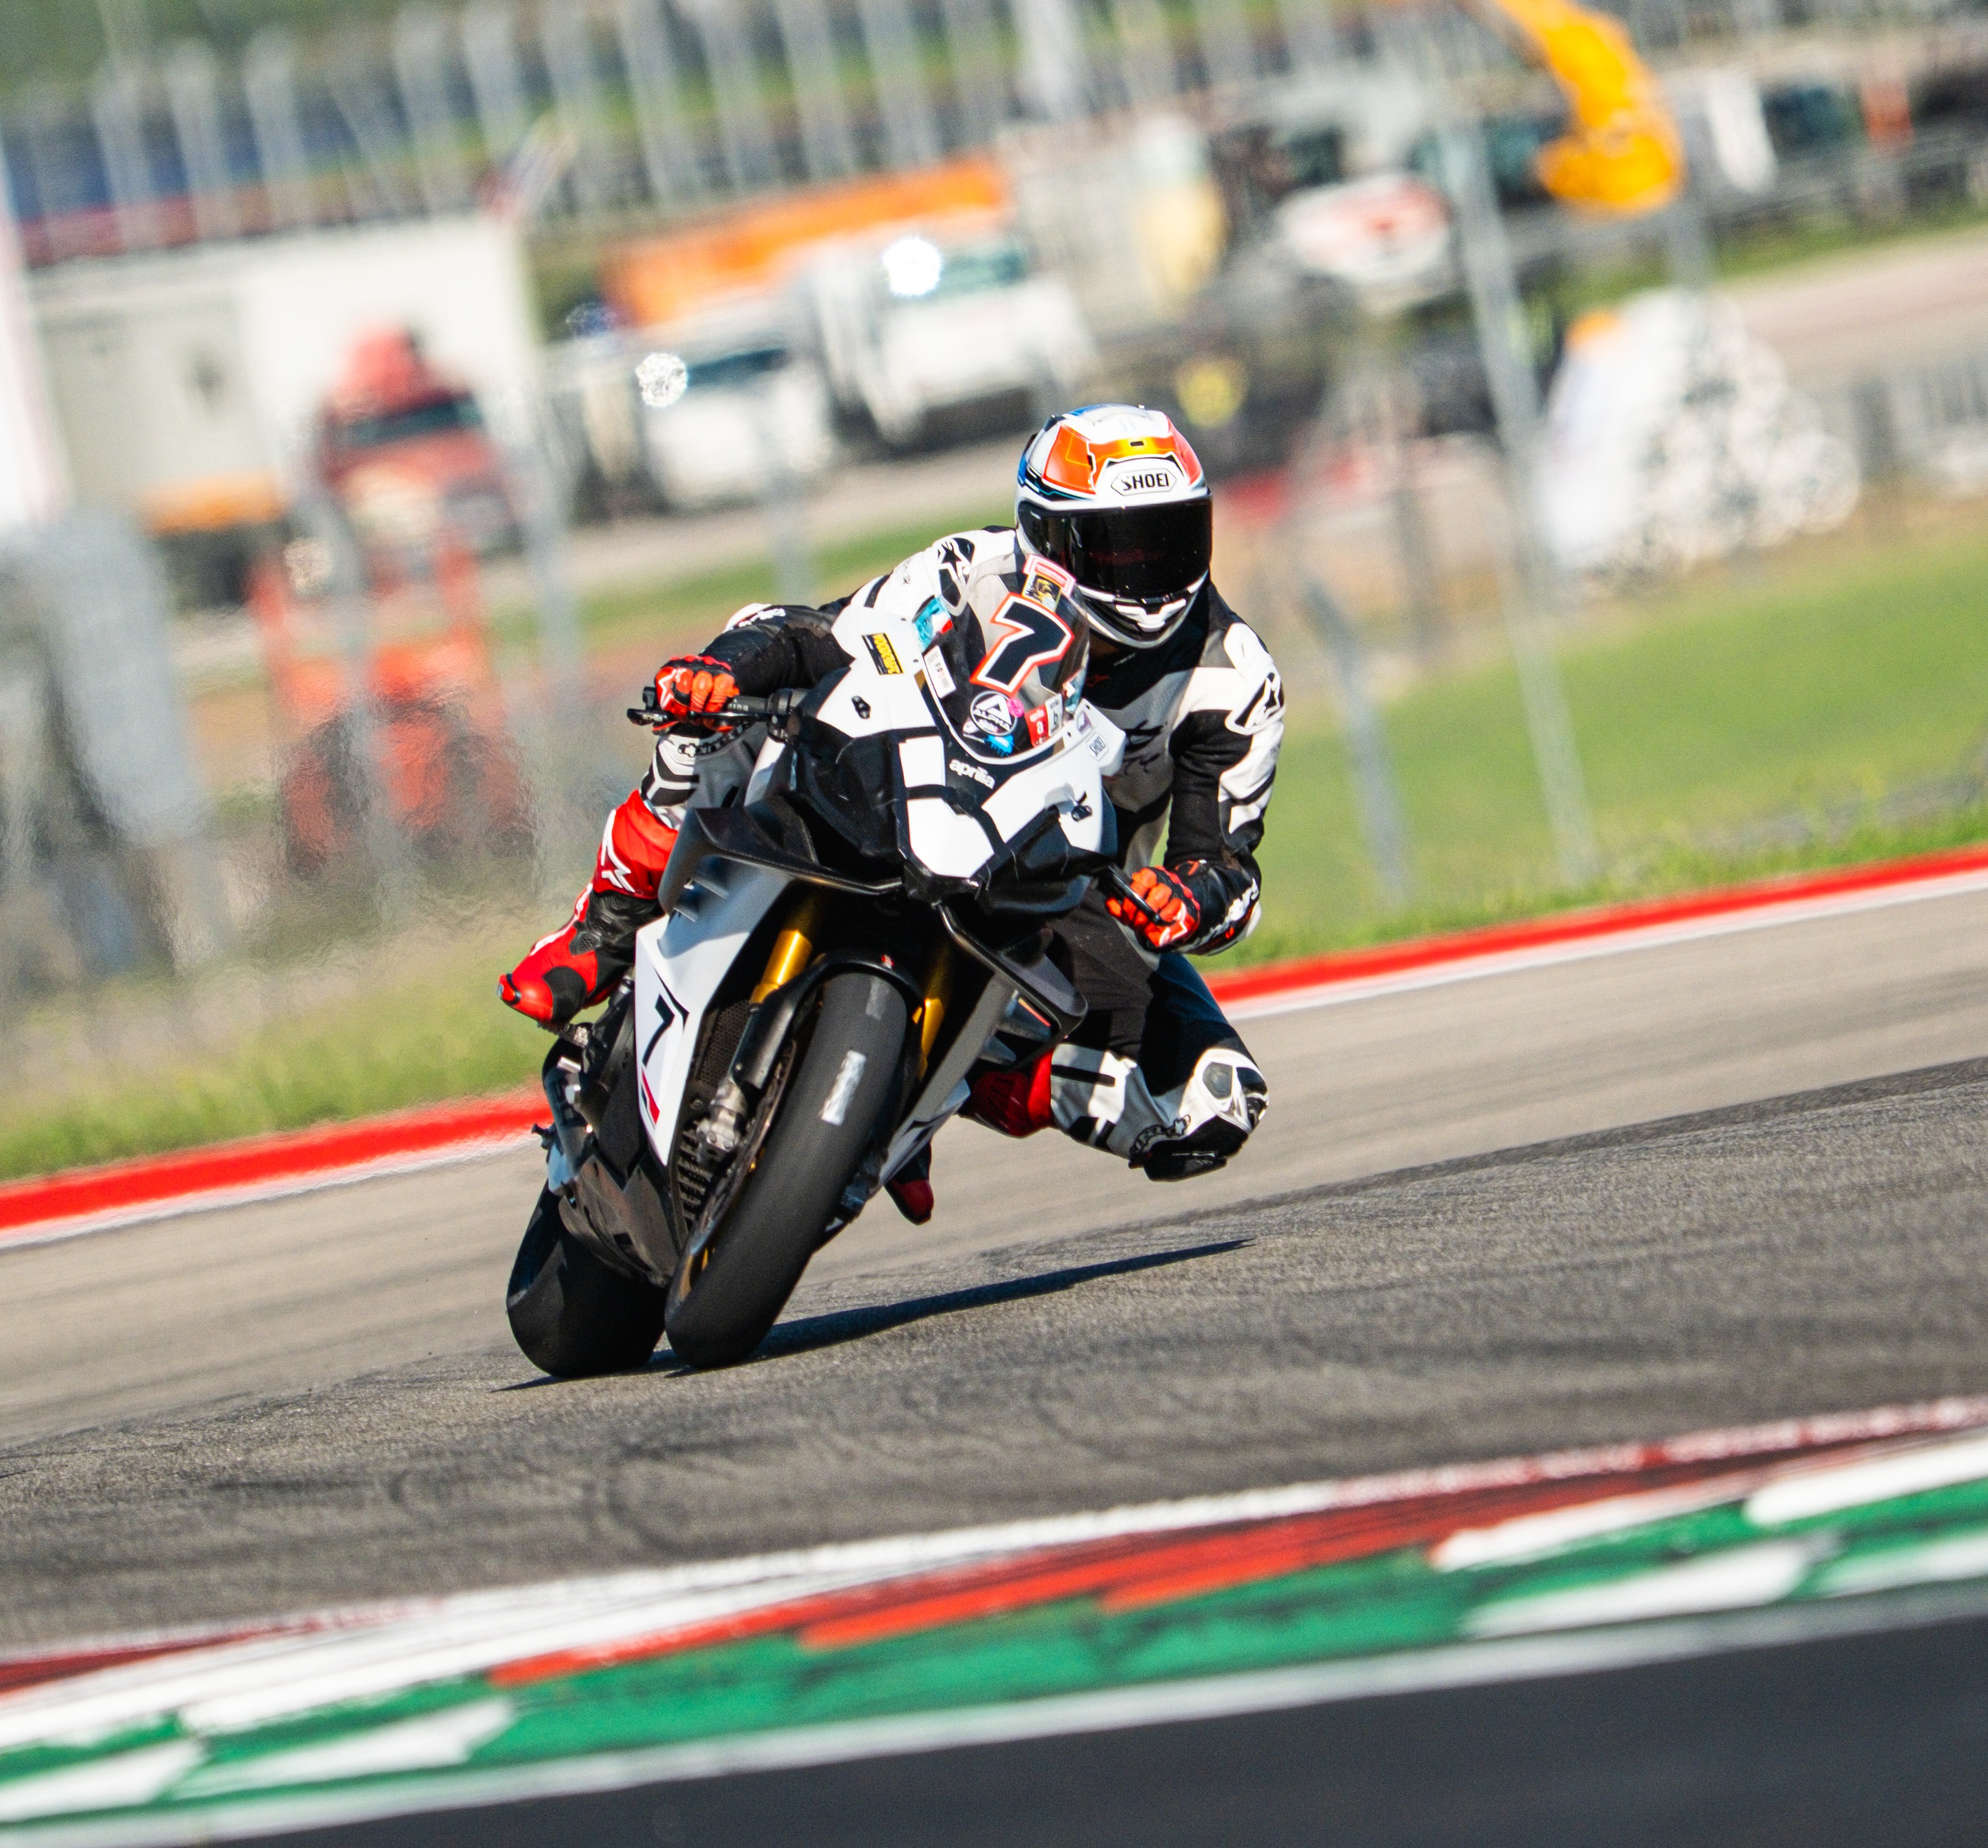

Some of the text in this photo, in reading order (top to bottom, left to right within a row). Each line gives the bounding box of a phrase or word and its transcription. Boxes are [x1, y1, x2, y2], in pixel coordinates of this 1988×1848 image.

[1120, 473, 1170, 491] SHOEI
[972, 593, 1073, 695] 7
[949, 759, 996, 789] aprilia
